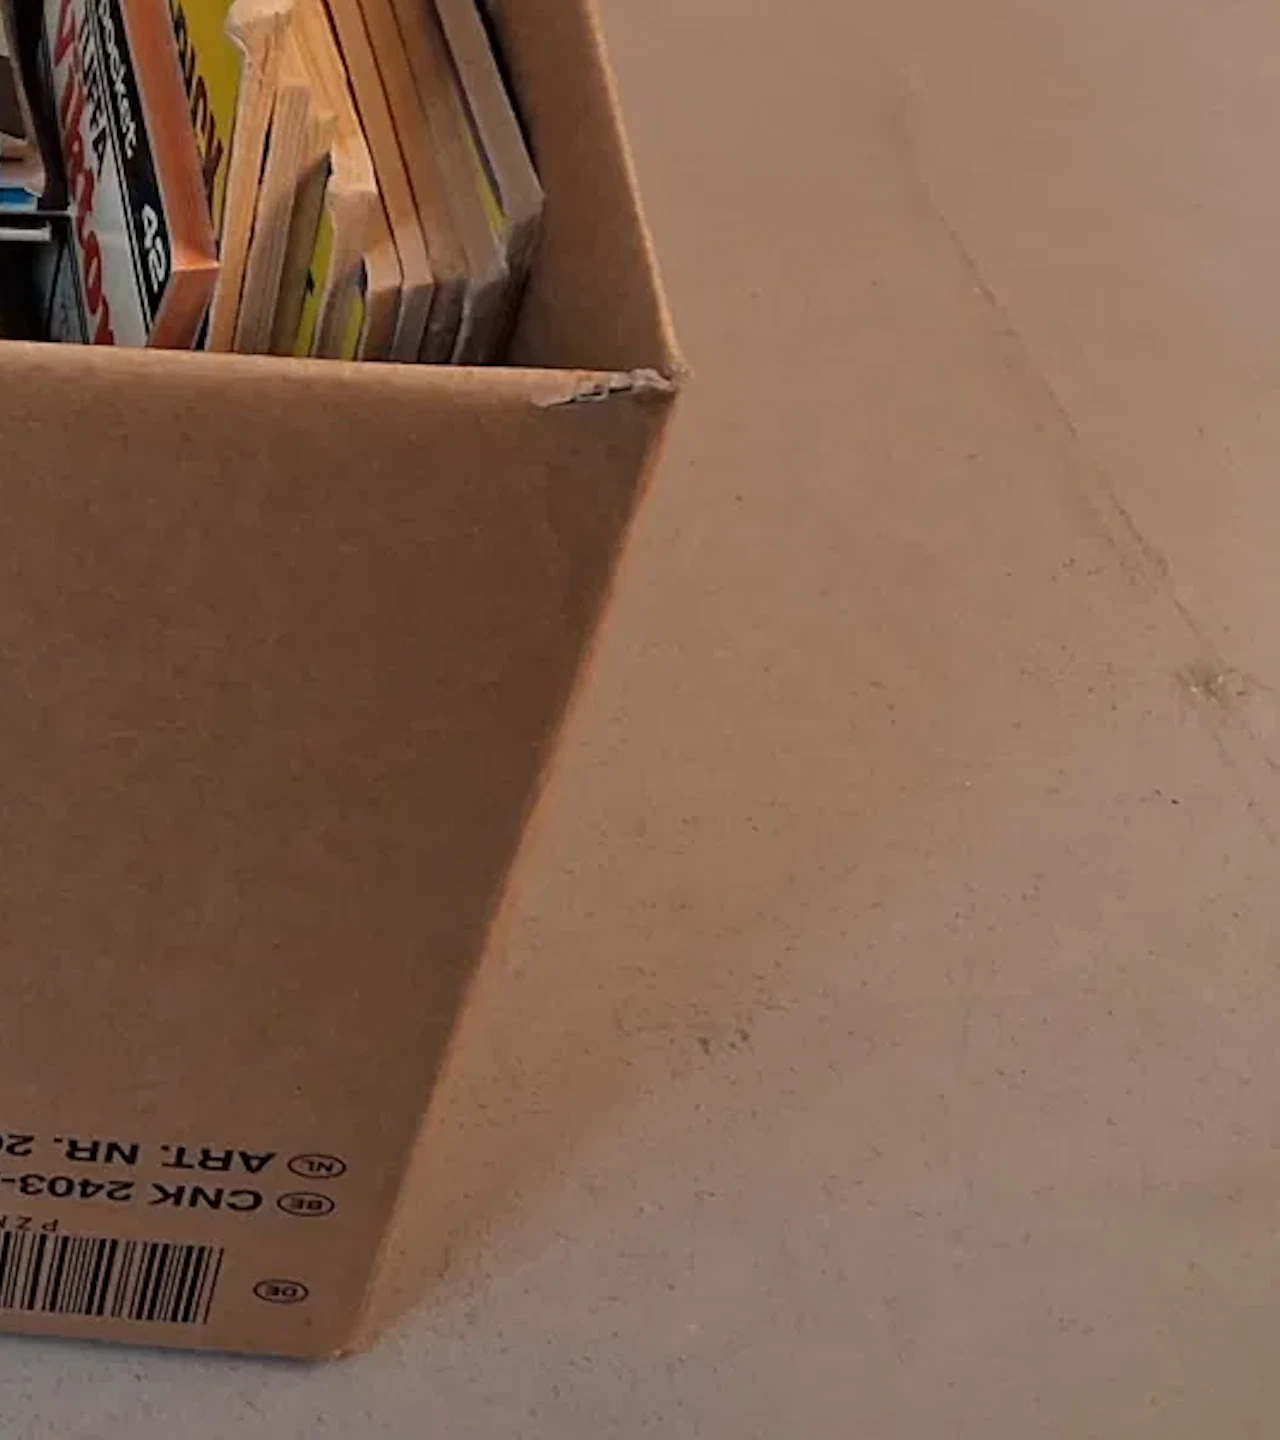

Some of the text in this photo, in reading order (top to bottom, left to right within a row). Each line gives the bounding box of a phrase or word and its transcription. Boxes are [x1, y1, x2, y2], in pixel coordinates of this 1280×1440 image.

[140, 205, 165, 291] 42
[52, 1136, 139, 1166] NR.
[161, 1144, 277, 1174] ART.
[149, 1184, 263, 1211] CNK
